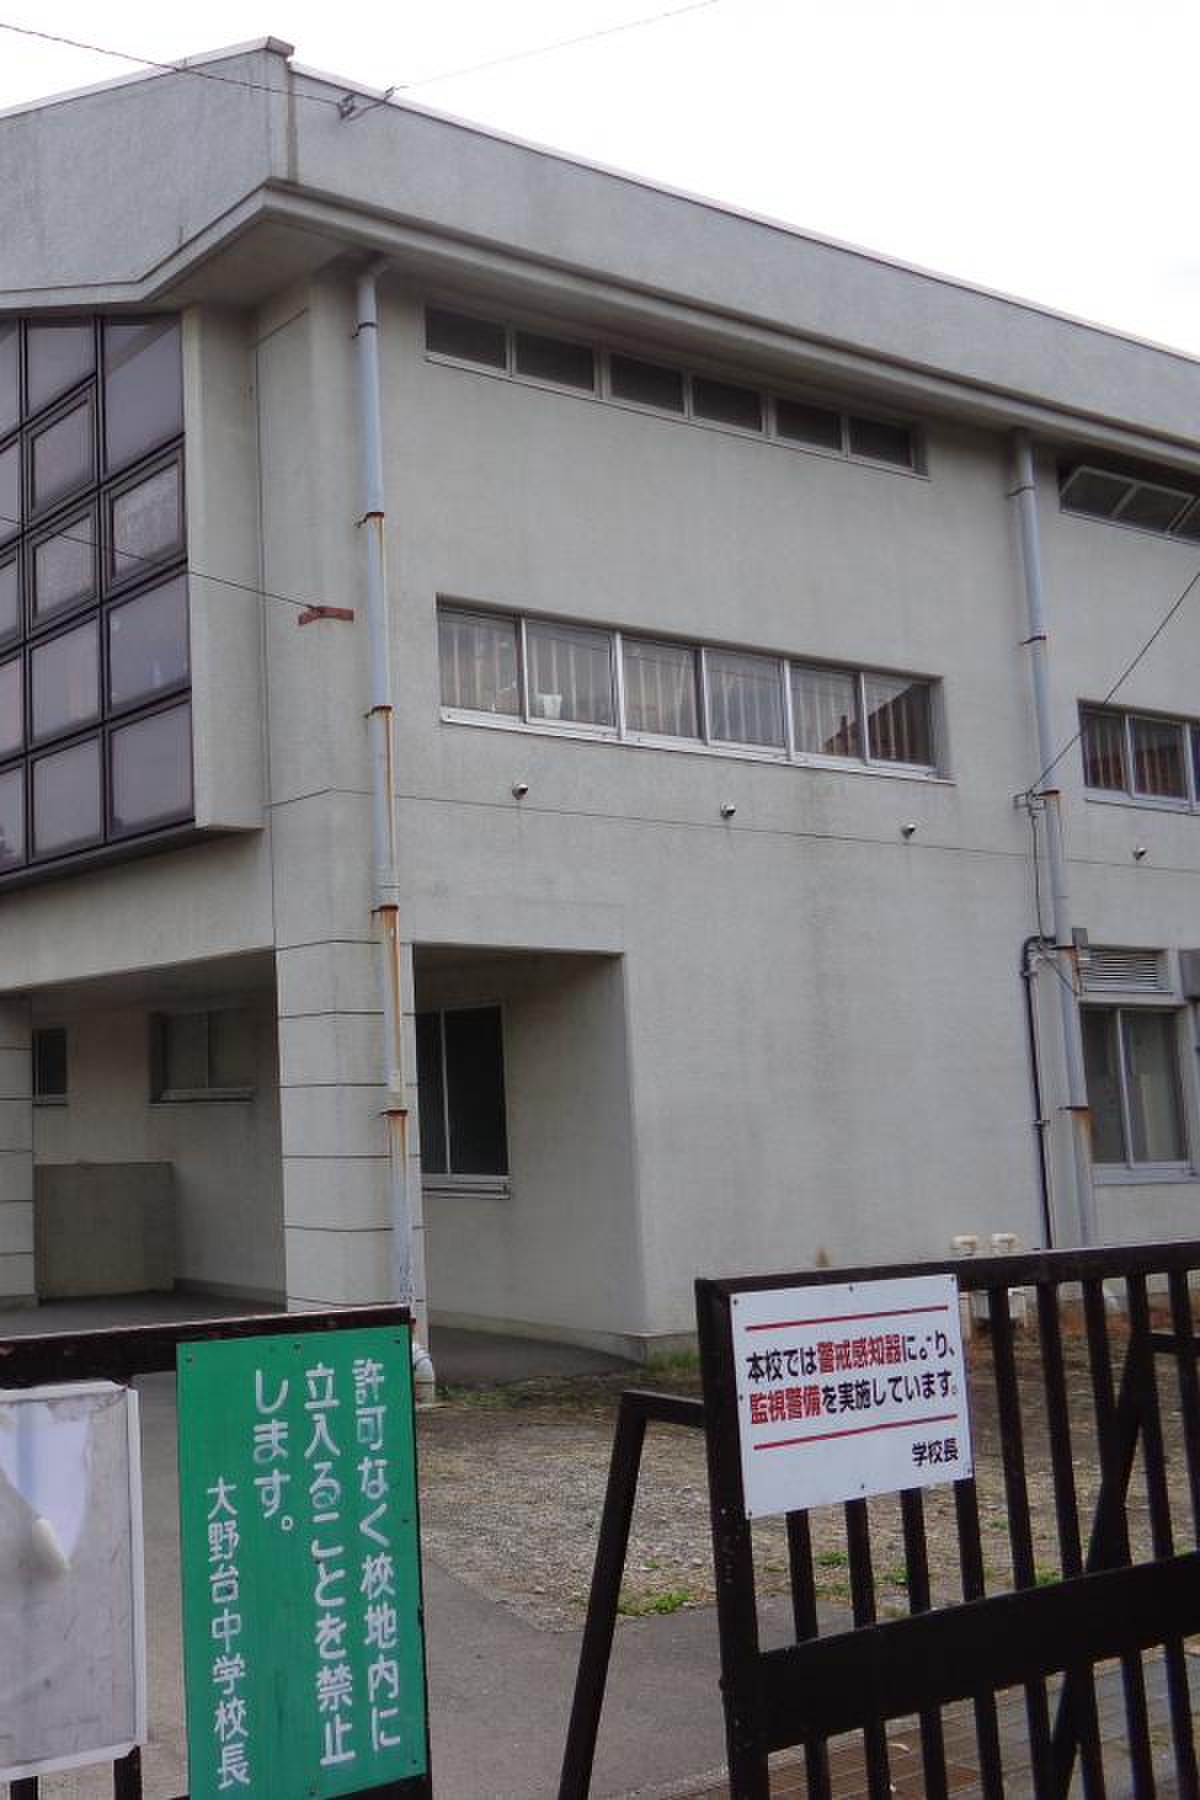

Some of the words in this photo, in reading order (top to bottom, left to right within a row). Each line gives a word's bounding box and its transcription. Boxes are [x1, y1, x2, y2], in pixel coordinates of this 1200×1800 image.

[252, 1367, 293, 1532] します。
[303, 1362, 356, 1766] 立入ることを禁止
[352, 1357, 401, 1752] 許可なく校地内に
[911, 1437, 959, 1467] 学校長
[206, 1476, 251, 1791] 大野台中学校長
